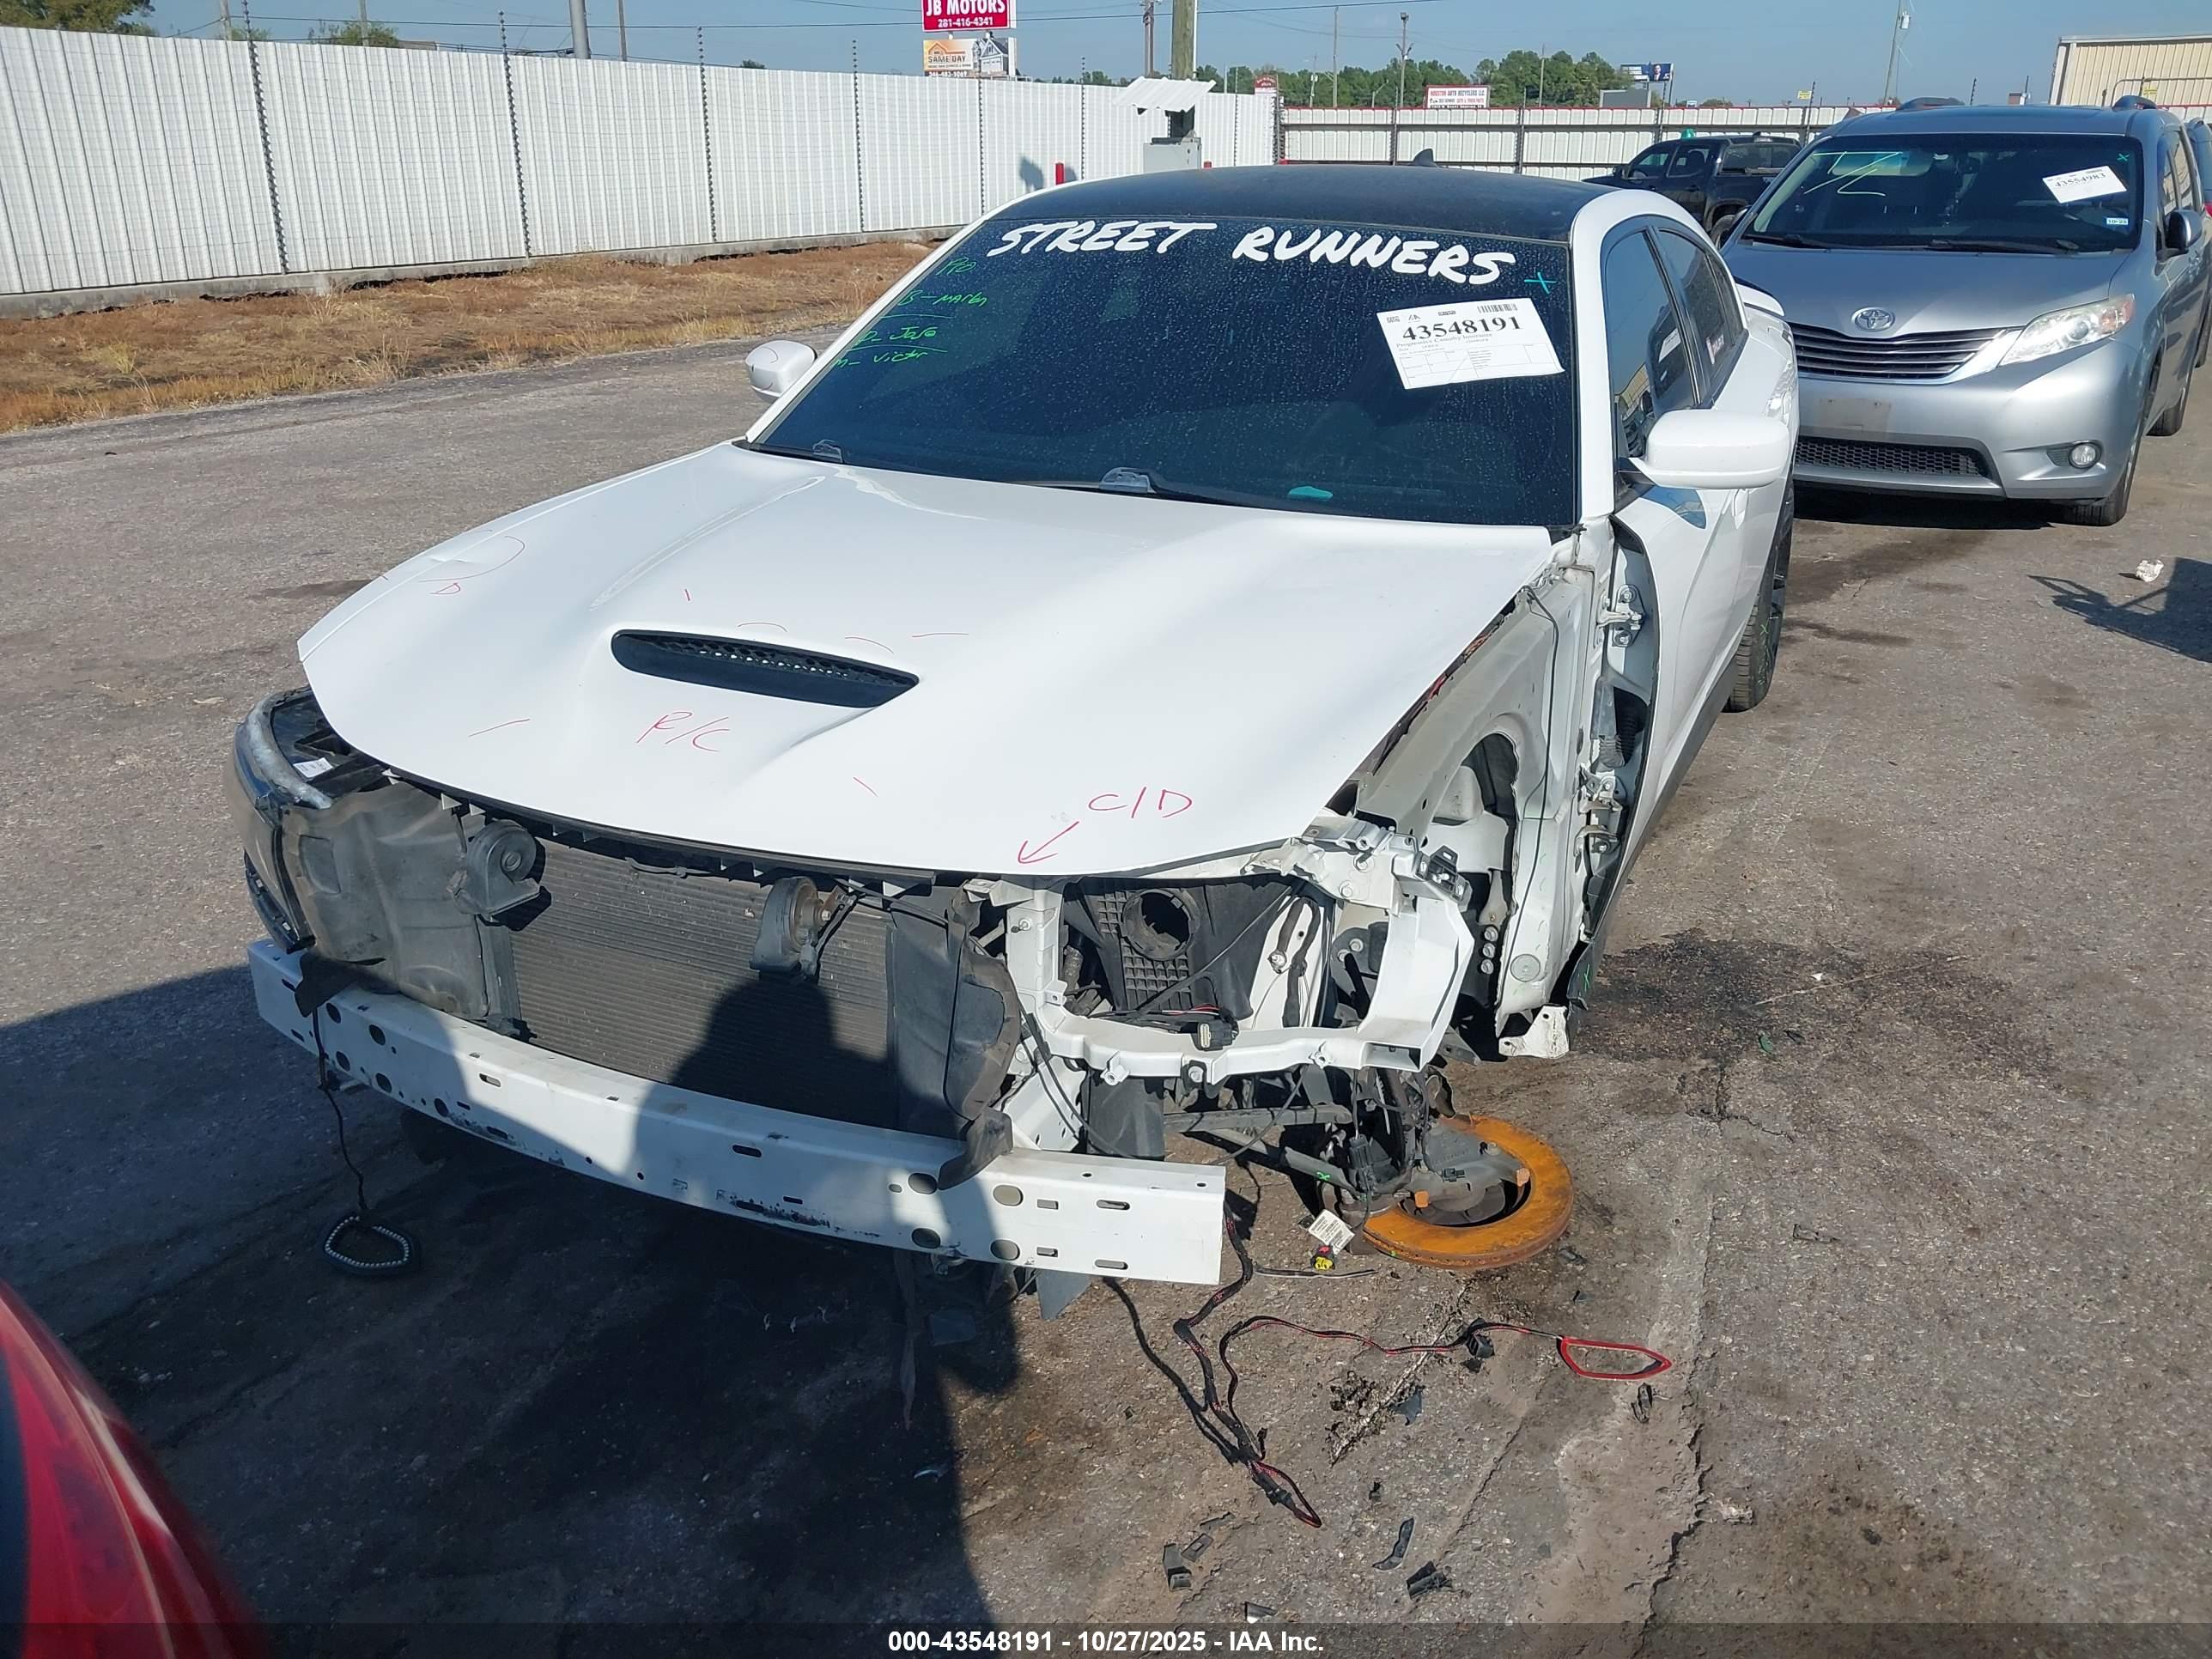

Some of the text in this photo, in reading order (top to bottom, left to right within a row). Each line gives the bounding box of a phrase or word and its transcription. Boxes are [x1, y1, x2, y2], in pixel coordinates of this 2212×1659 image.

[926, 0, 1006, 16] JB MOTORS
[988, 220, 1516, 286] STREET RUNNERS
[1402, 315, 1523, 341] 43548191
